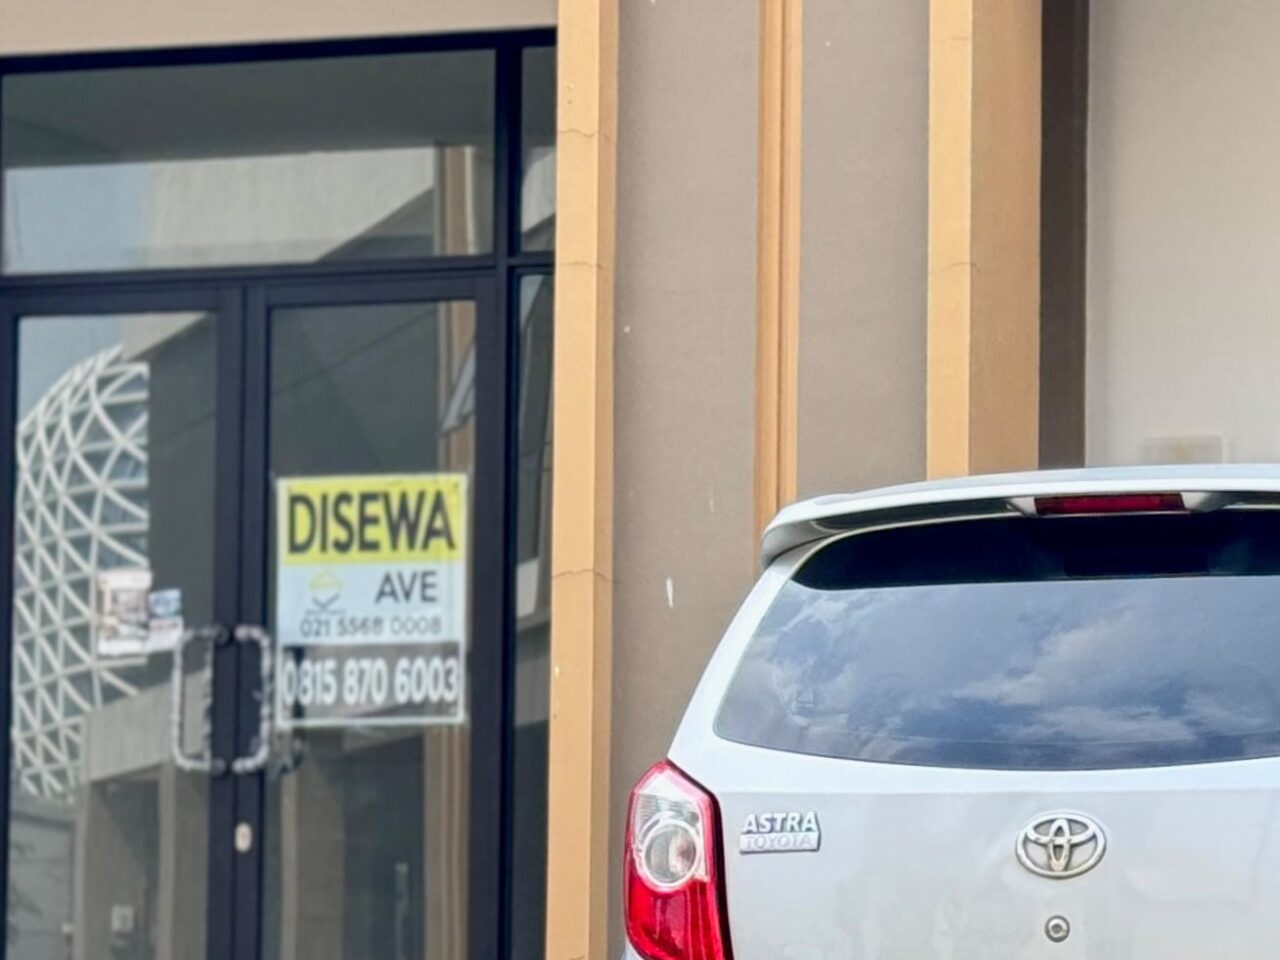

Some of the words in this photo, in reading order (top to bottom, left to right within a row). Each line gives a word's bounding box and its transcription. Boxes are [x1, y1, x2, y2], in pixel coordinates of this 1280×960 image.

[287, 490, 456, 553] DISEWA
[374, 571, 438, 604] AVE
[301, 617, 331, 638] 021
[390, 615, 443, 635] 0008
[284, 657, 338, 707] 0815
[344, 656, 389, 705] 870
[394, 656, 460, 705] 6003
[741, 811, 819, 834] ASTRA
[745, 834, 813, 850] TOYOTA
